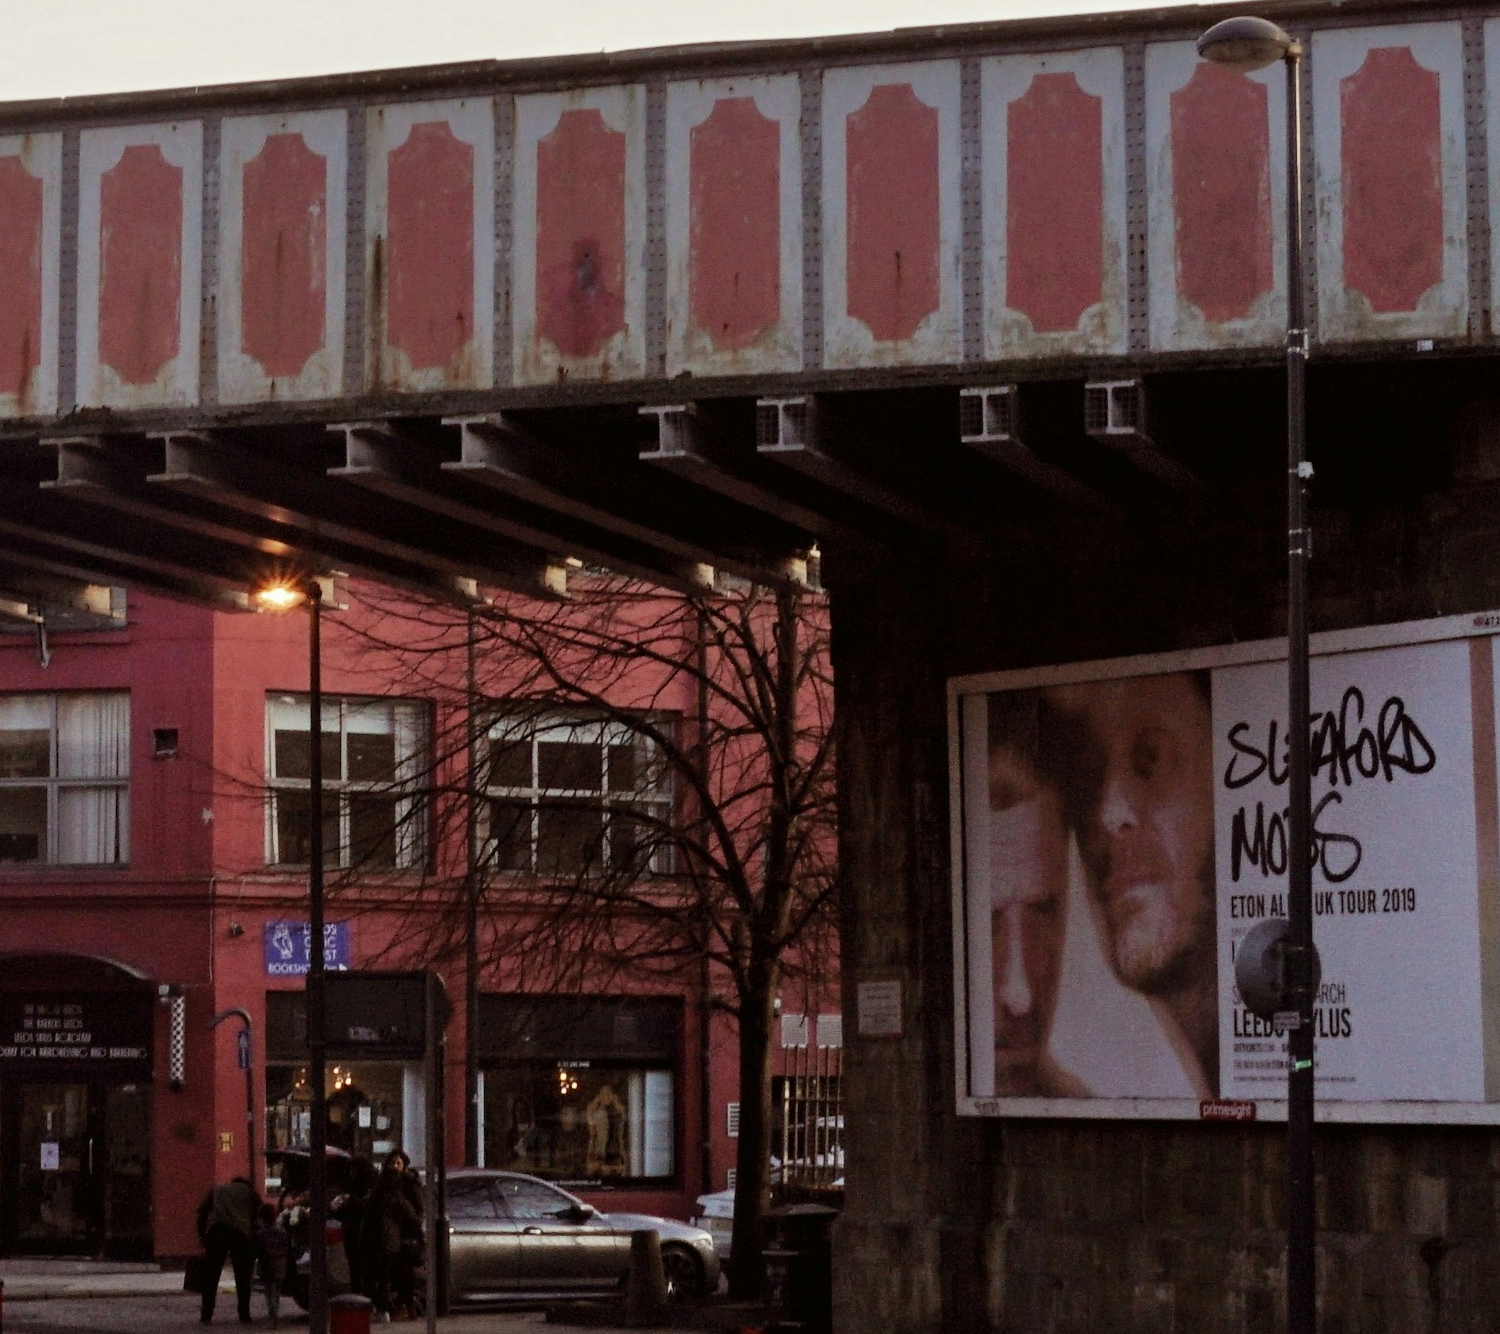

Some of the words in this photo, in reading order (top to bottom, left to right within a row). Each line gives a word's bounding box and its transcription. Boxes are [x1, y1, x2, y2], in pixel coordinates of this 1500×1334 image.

[1231, 895, 1265, 918] ETON
[1314, 891, 1334, 916] UK
[1338, 889, 1377, 914] TOUR
[1382, 887, 1416, 912] 2019
